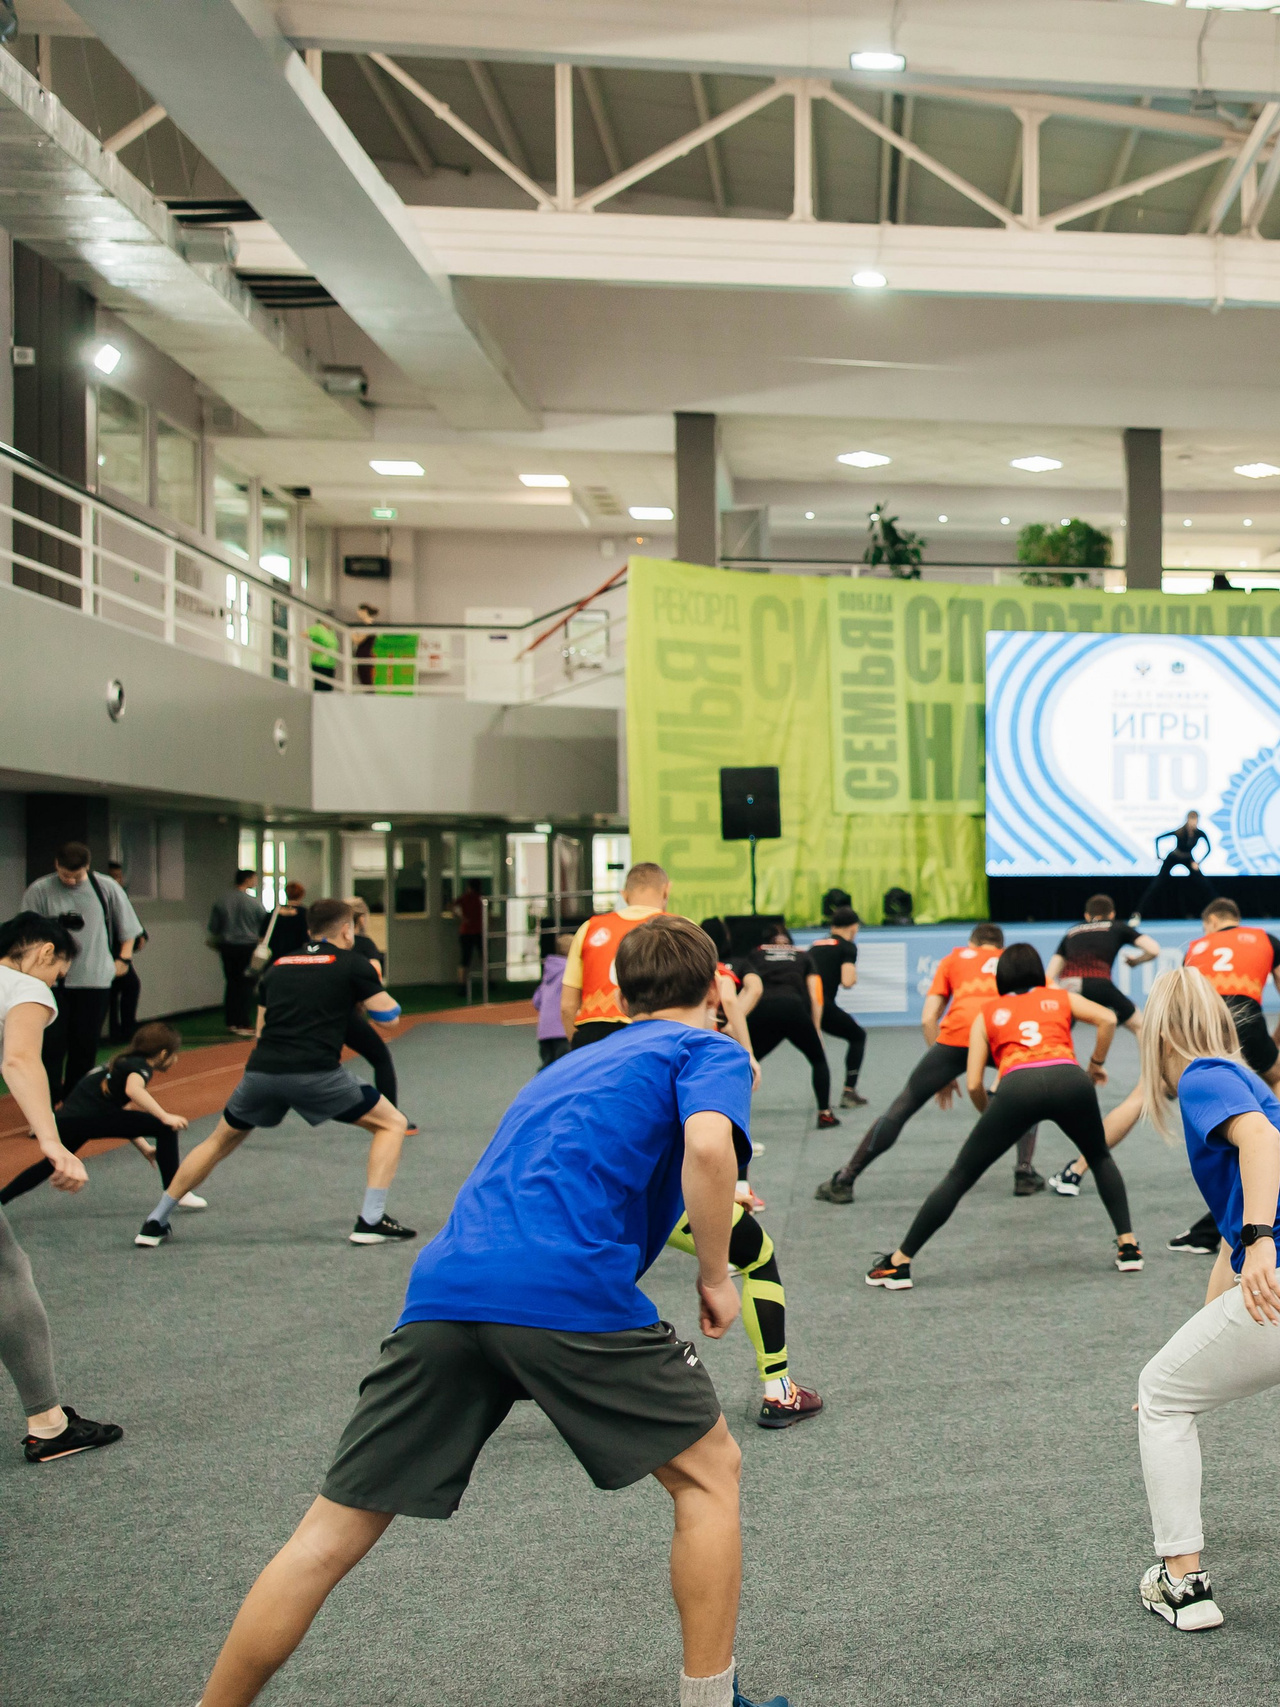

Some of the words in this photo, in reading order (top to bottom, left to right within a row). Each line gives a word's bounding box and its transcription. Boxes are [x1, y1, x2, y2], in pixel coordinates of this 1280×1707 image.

[653, 585, 741, 633] РЕКОРД
[839, 617, 899, 800] СЕМЬЯ
[1111, 712, 1209, 741] ИГРЫ
[655, 638, 746, 882] СЕМЬЯ
[1112, 744, 1209, 801] ГТО
[981, 957, 999, 974] 4
[1212, 947, 1234, 972] 2
[1018, 1020, 1042, 1047] 3
